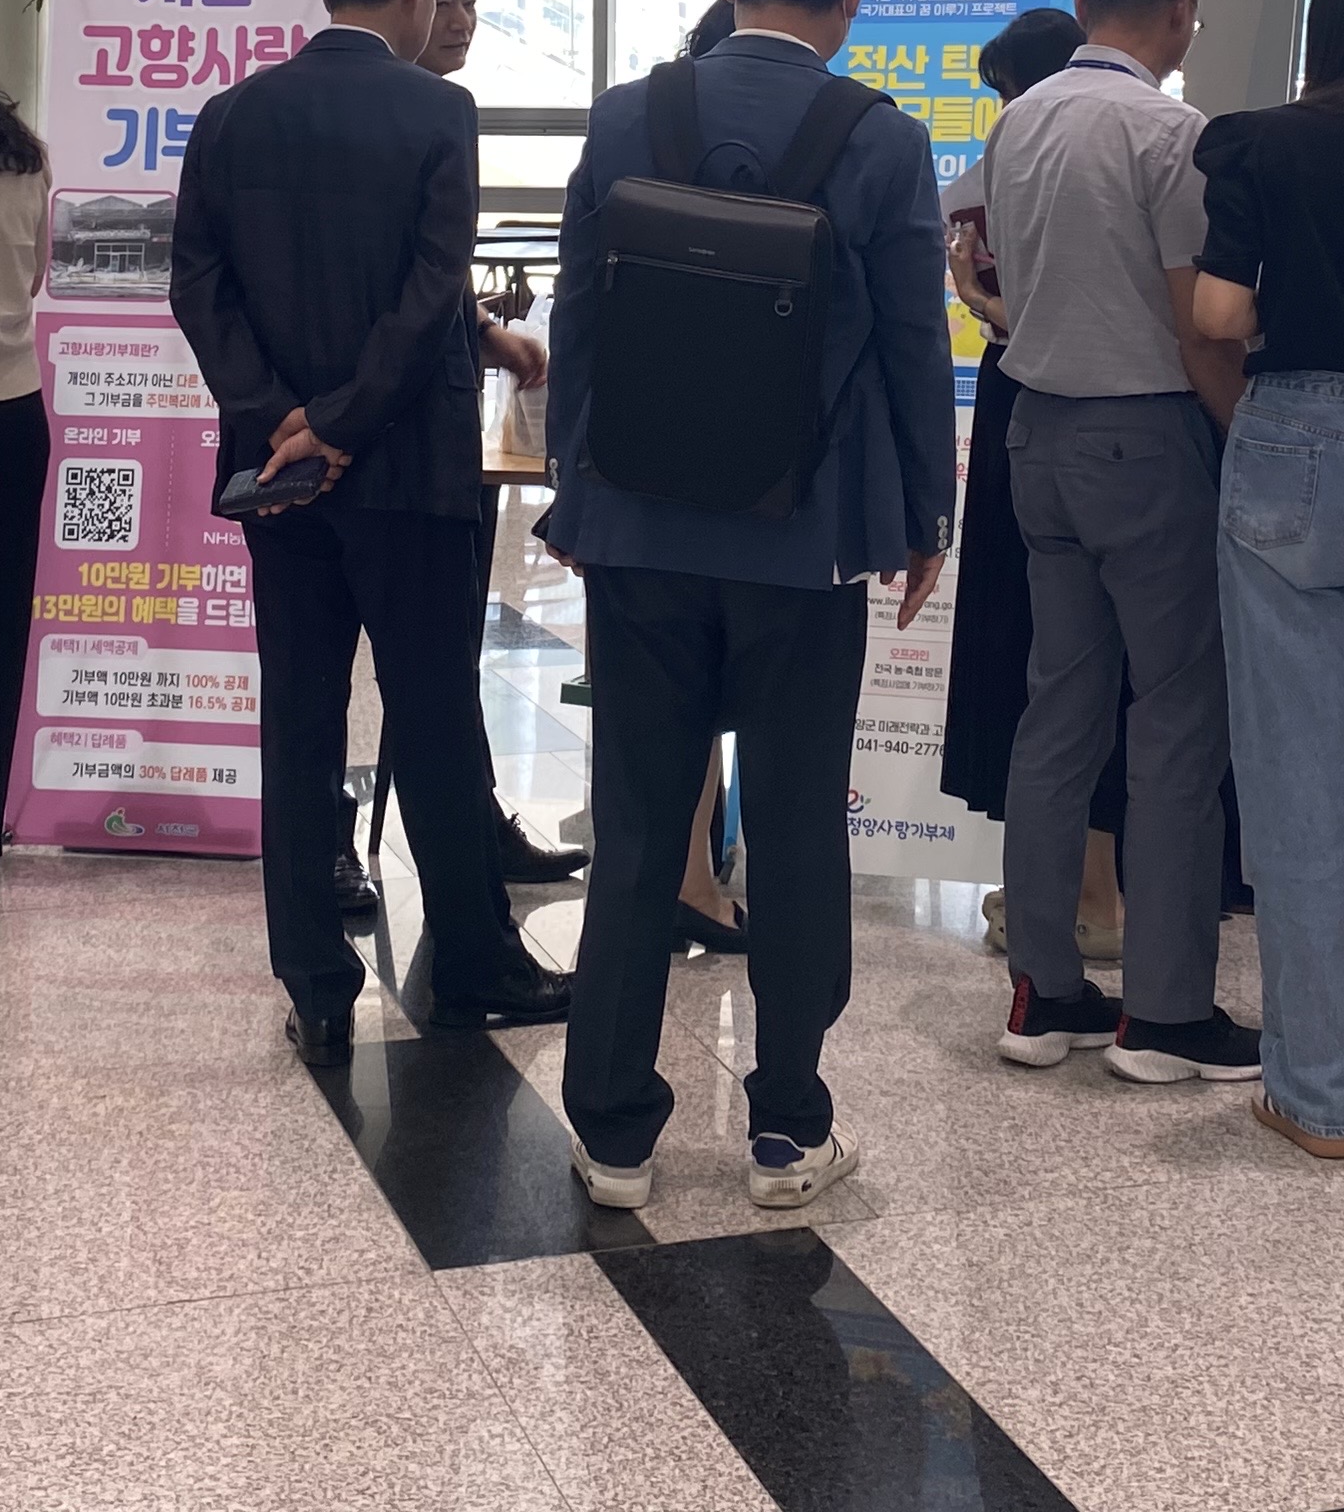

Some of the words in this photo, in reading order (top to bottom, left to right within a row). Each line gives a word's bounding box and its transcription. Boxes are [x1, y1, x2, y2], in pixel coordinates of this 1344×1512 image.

[860, 3, 916, 16] 국가대표의
[919, 4, 931, 16] 꿈
[934, 3, 968, 16] 이루기
[971, 2, 1017, 16] 프로젝트
[848, 45, 930, 90] 정산
[58, 341, 159, 357] 고향사랑기부제란?
[67, 371, 101, 387] 개인이
[104, 372, 149, 387] 주소지가
[151, 374, 174, 388] 아닌
[176, 374, 199, 388] 다른
[84, 392, 96, 406] 그
[99, 392, 143, 407] 기부금을
[146, 393, 202, 408] 주민복리에
[205, 398, 219, 409] 사
[64, 427, 107, 445] 온라인
[112, 429, 141, 445] 기부
[200, 430, 220, 447] 오
[78, 562, 151, 590] 10만원
[156, 563, 247, 593] 기부하면
[32, 594, 125, 624] 13만원의
[131, 596, 199, 625] 혜택을
[204, 599, 256, 627] 드립
[90, 639, 139, 655] 세액공제
[71, 669, 108, 686] 기부액
[112, 671, 152, 687] 10만원
[156, 672, 181, 688] 까지
[185, 675, 220, 689] 100%
[223, 675, 250, 691] 공제
[62, 690, 99, 705] 기부액
[103, 692, 143, 708] 10만원
[146, 693, 184, 709] 초과분
[188, 696, 228, 711] 16.5%
[231, 697, 257, 712] 공제
[91, 733, 127, 749] 답례품
[72, 762, 135, 779] 기부금액의
[139, 765, 167, 780] 30%
[170, 766, 208, 783] 답례품
[211, 768, 238, 784] 제공
